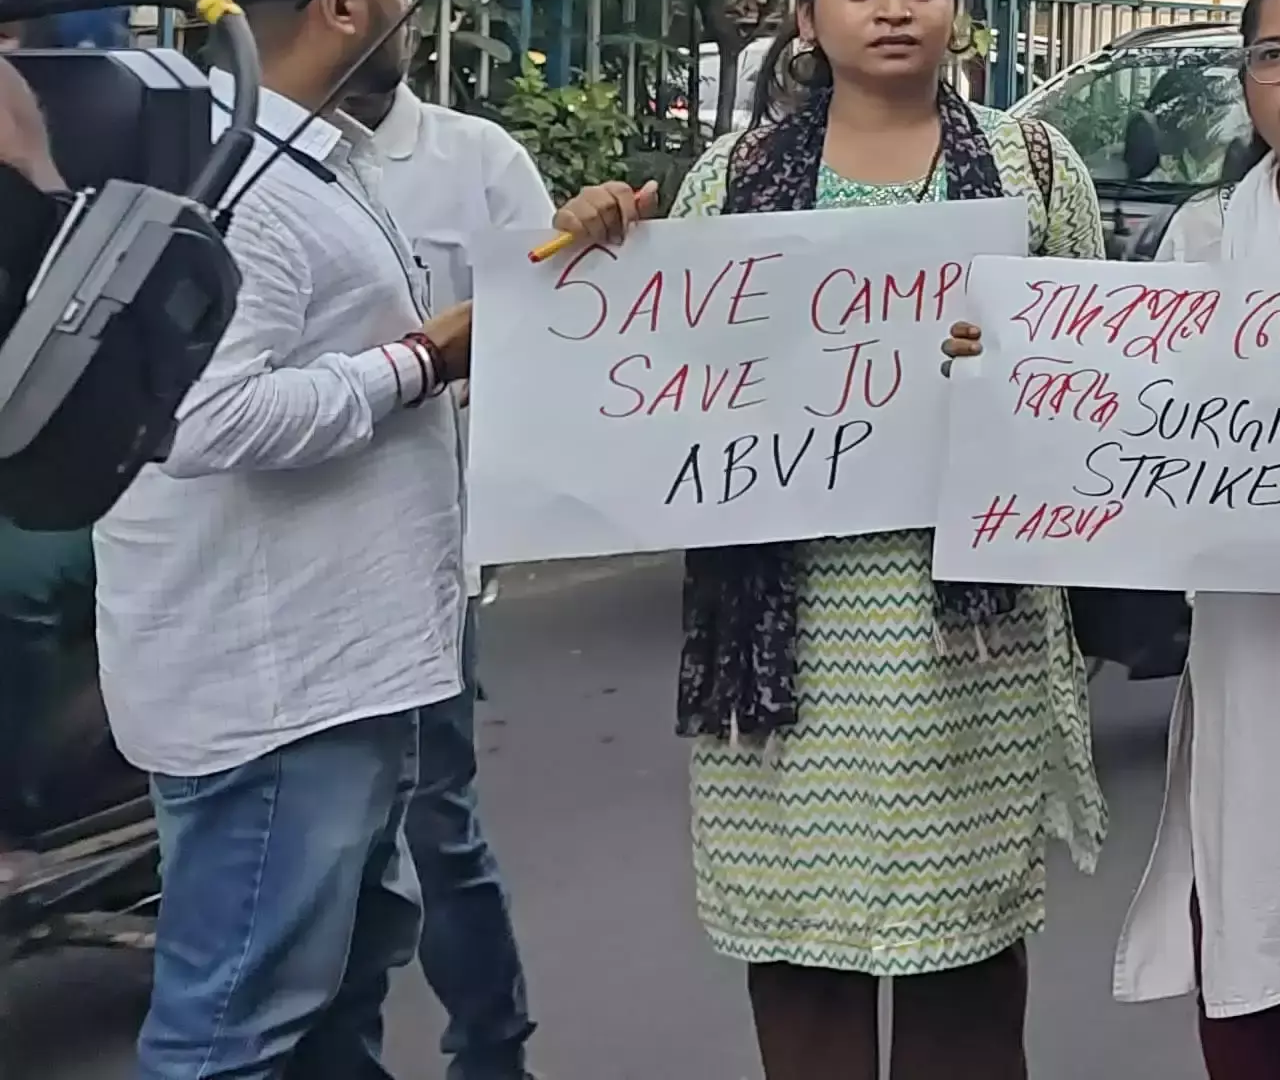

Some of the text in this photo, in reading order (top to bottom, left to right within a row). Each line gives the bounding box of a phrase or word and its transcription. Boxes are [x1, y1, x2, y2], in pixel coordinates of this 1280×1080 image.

[547, 243, 972, 340] SAVE CAMP
[599, 339, 902, 417] SAVE JU
[665, 420, 873, 505] ABVP
[971, 495, 1124, 549] #ABVP
